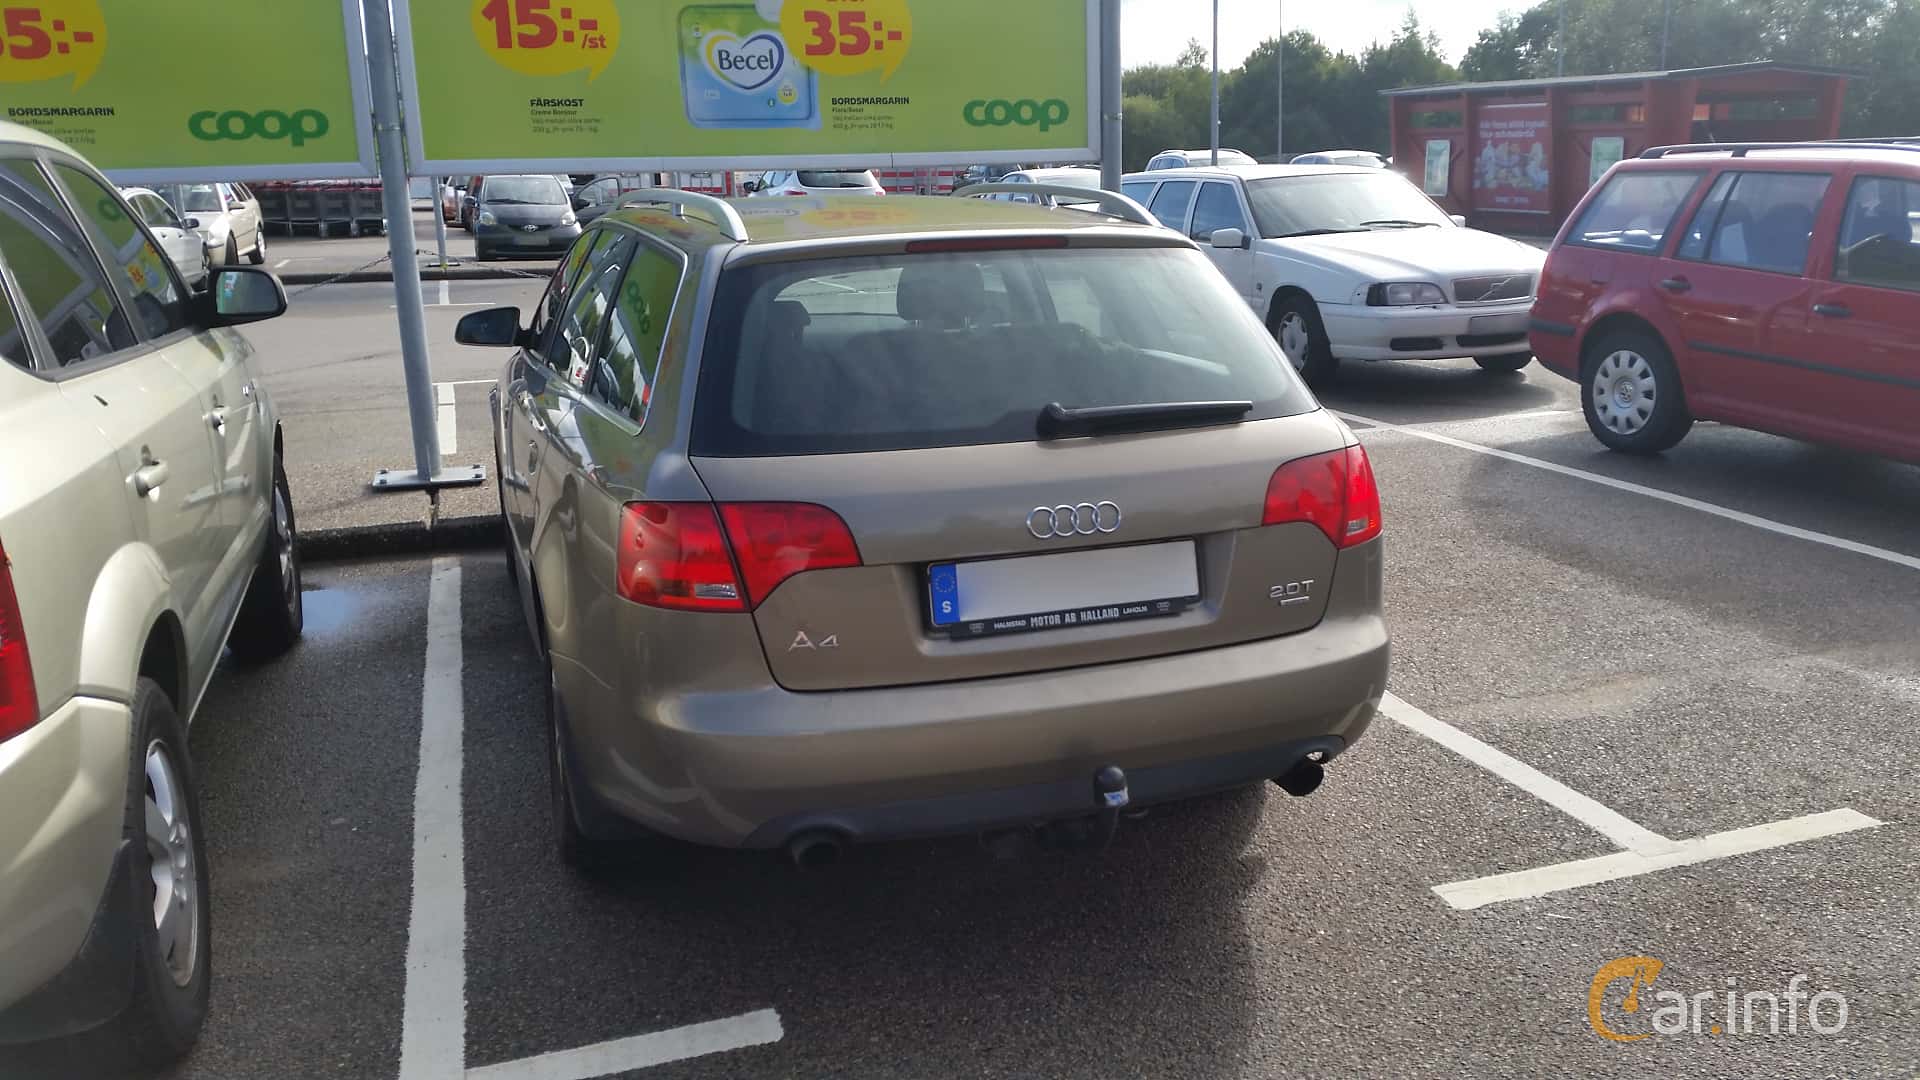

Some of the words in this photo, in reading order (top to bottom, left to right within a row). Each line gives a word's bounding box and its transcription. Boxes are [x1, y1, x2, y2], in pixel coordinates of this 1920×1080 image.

[0, 8, 94, 59] 5:-
[482, 0, 598, 48] 15:-
[804, 10, 902, 55] 35:-
[582, 33, 607, 49] /st
[718, 48, 775, 70] Becel
[8, 107, 115, 116] BORDSMARGARIN
[530, 97, 584, 107] FÄRSKOST
[832, 97, 909, 105] BORDSMARGARIN
[963, 99, 1069, 131] coop
[188, 109, 329, 146] coop
[942, 600, 952, 613] S
[1030, 613, 1061, 628] MOTOR
[1065, 613, 1077, 624] AB
[1080, 607, 1119, 622] HALLAND
